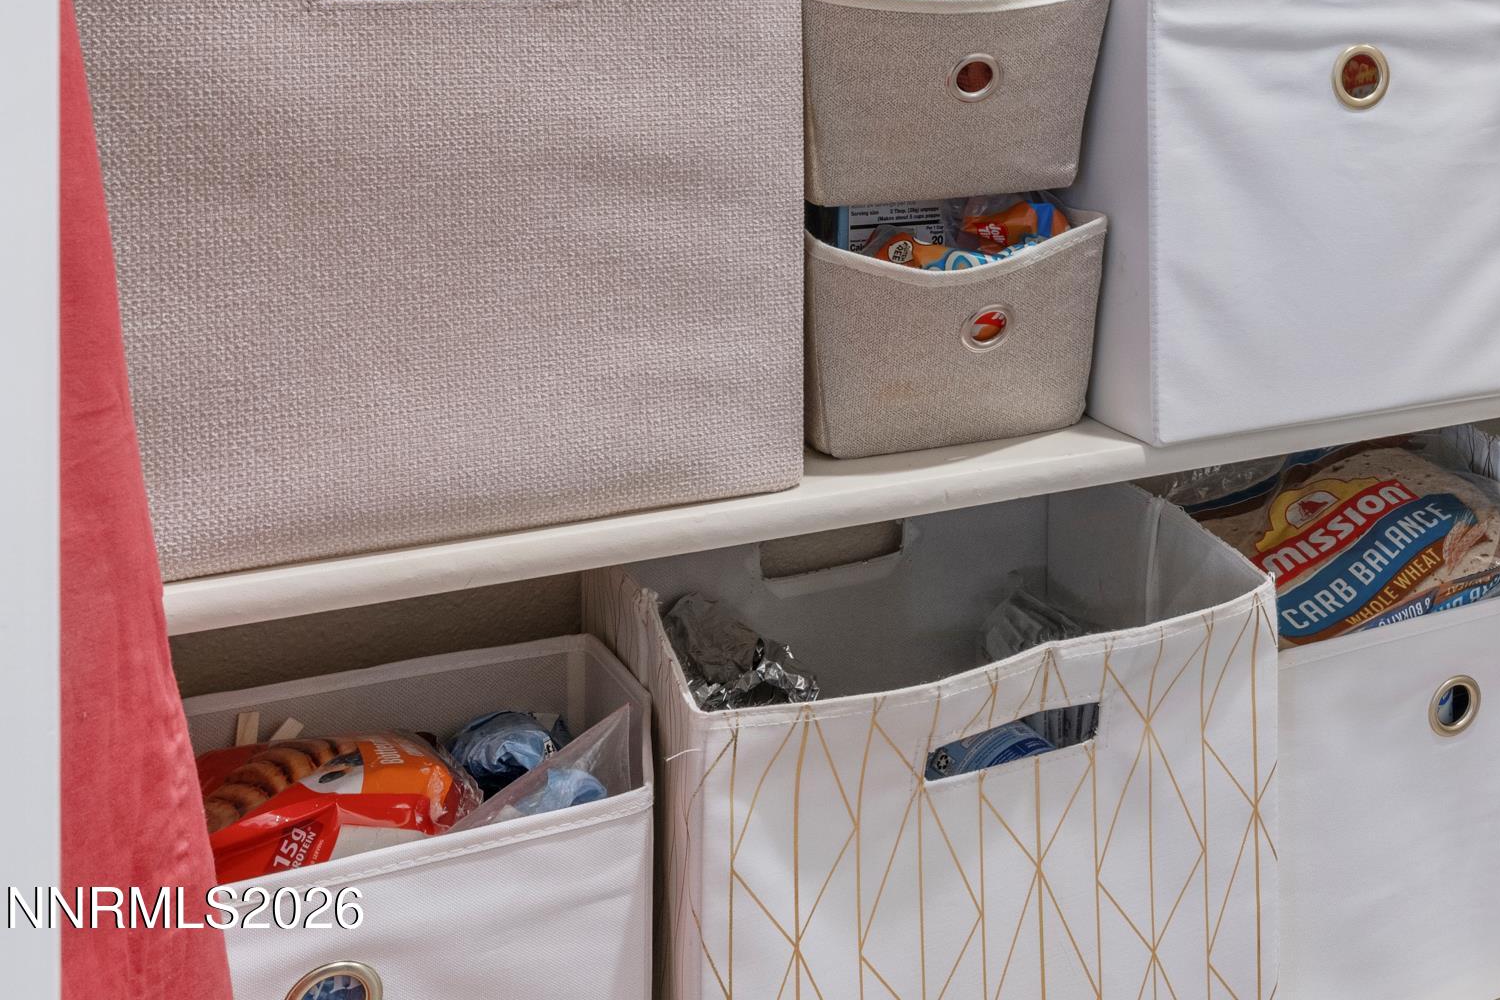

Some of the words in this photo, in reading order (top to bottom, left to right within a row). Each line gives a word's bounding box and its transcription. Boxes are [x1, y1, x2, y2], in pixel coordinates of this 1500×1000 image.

[931, 235, 944, 246] 20
[1261, 485, 1412, 577] MISSION
[1281, 577, 1358, 630] CARB
[1347, 502, 1452, 586] BALANCE
[1345, 586, 1398, 626] WHOLE
[1393, 547, 1442, 590] WHEAT
[273, 826, 308, 869] 15g
